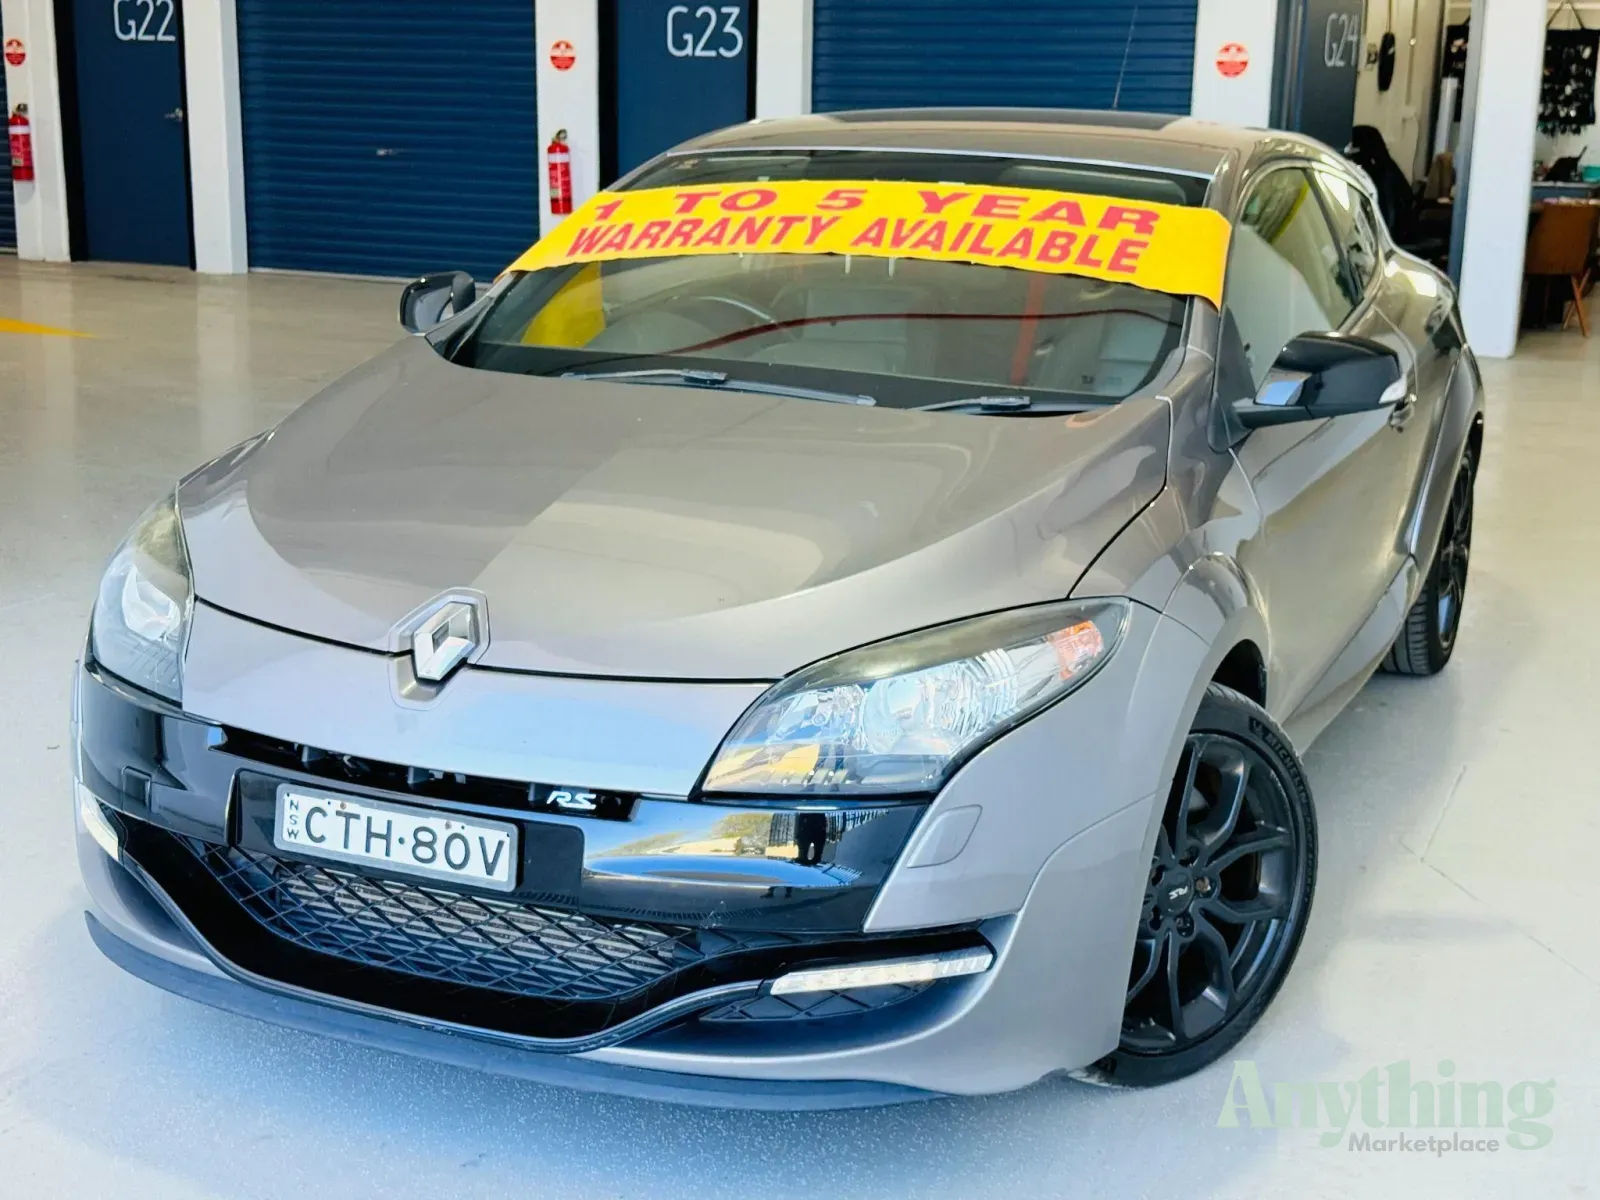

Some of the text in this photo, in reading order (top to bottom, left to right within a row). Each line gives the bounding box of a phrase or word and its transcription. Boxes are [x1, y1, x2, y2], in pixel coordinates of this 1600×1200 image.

[114, 0, 176, 41] G22
[667, 6, 743, 58] G23
[1324, 12, 1358, 67] G24
[594, 189, 1160, 235] 1 TO 5 YEAR
[566, 216, 1150, 274] WARRANTY AVAILABLE
[546, 790, 597, 810] RS
